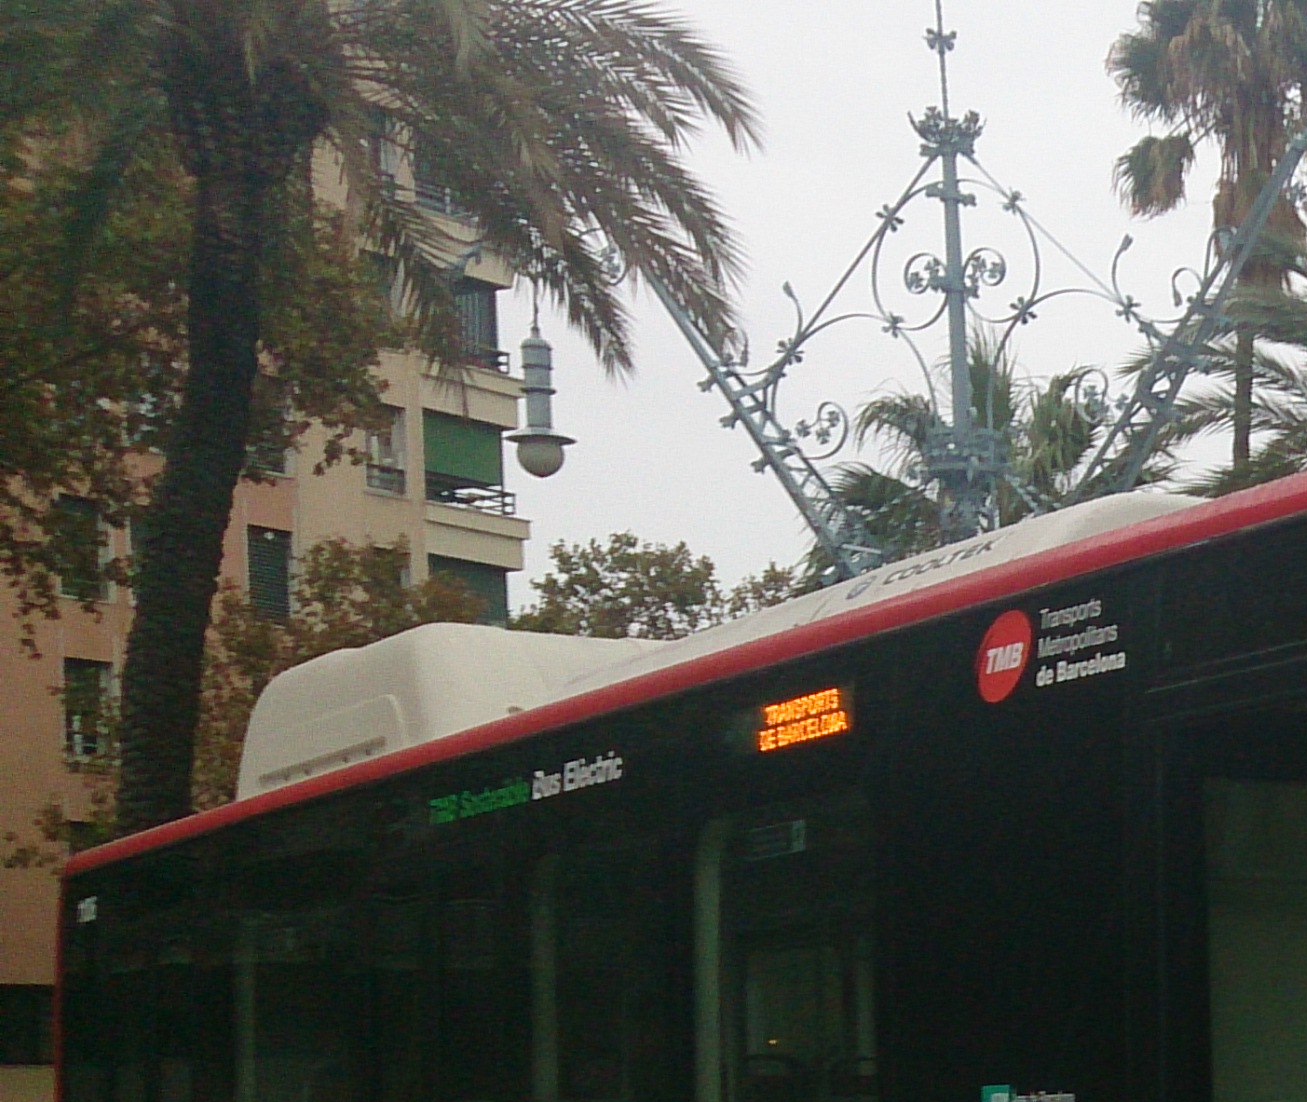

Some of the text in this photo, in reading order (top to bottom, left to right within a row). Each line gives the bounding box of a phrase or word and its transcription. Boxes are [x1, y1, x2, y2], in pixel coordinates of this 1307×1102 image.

[985, 642, 1025, 674] TMB
[1035, 651, 1126, 687] de Barcelona
[764, 688, 839, 726] TRANSPORTS
[759, 711, 848, 751] DE BARCELONA
